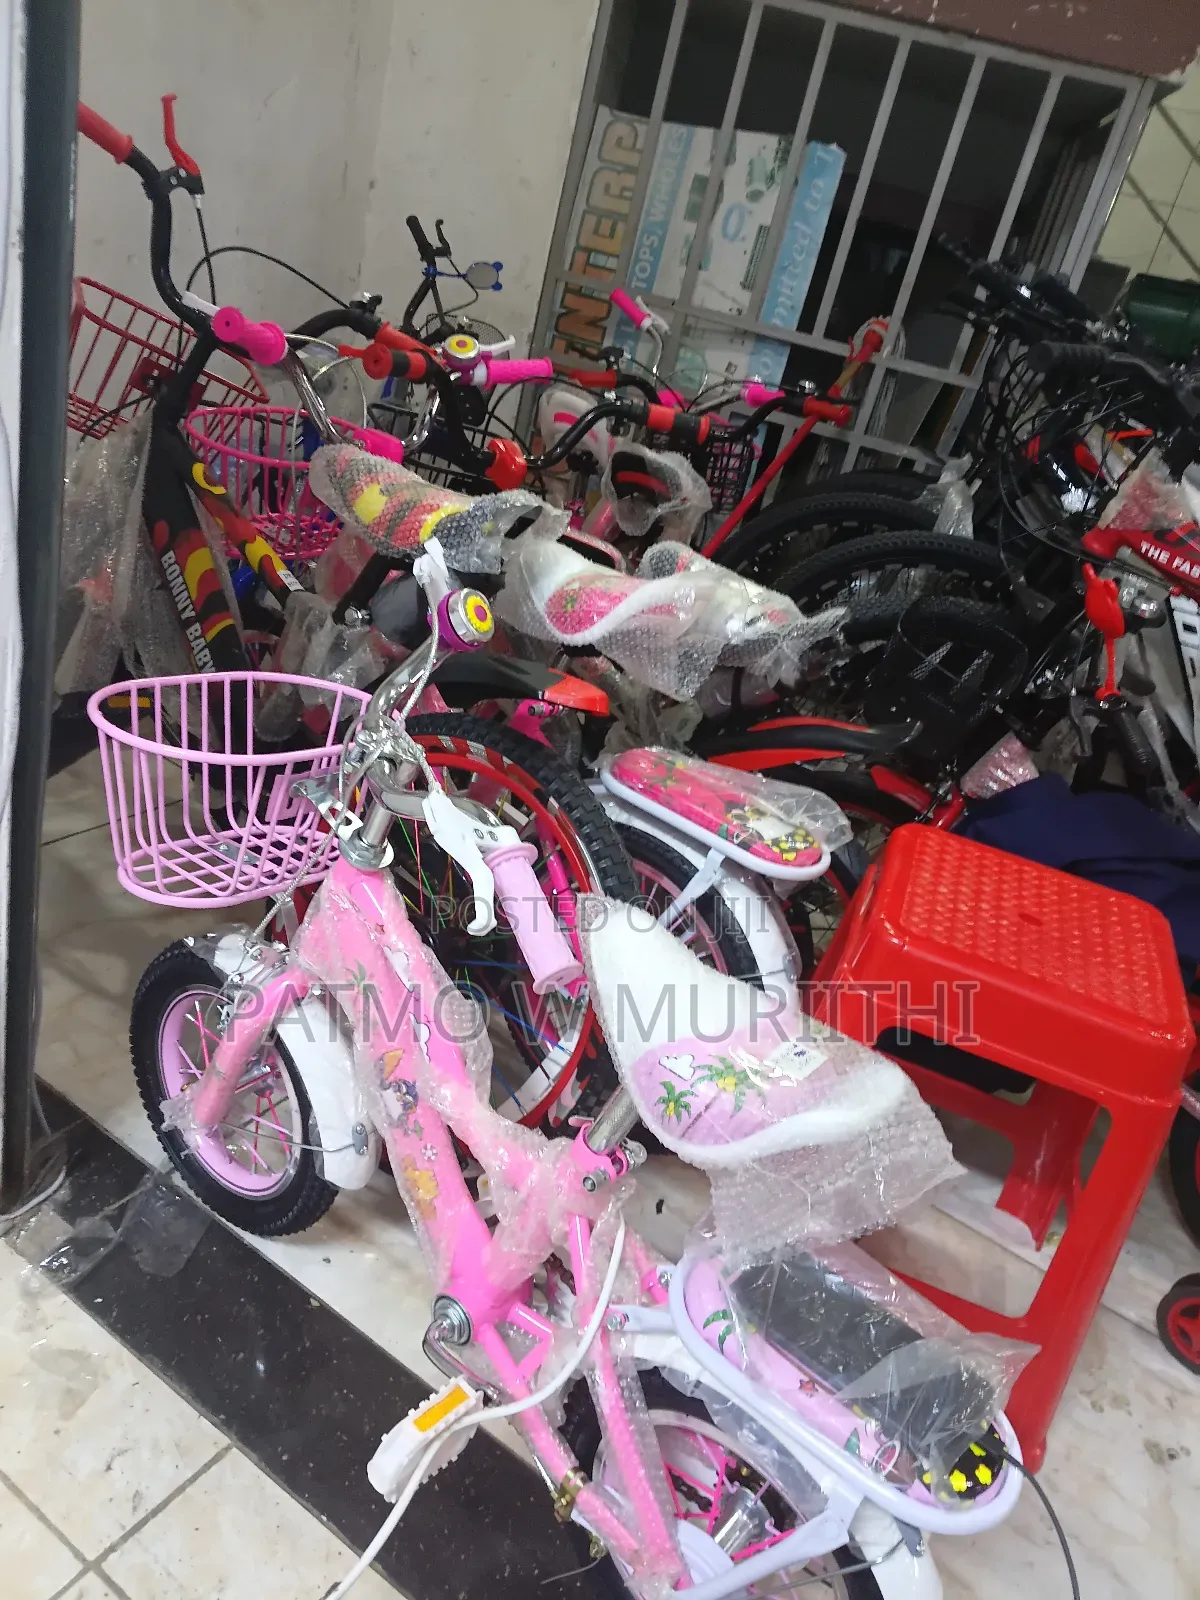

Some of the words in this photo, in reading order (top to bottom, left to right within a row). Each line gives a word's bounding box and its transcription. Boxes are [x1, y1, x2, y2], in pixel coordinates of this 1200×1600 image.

[1140, 540, 1171, 565] THE
[160, 549, 197, 621] BONNY
[185, 621, 217, 673] BABY
